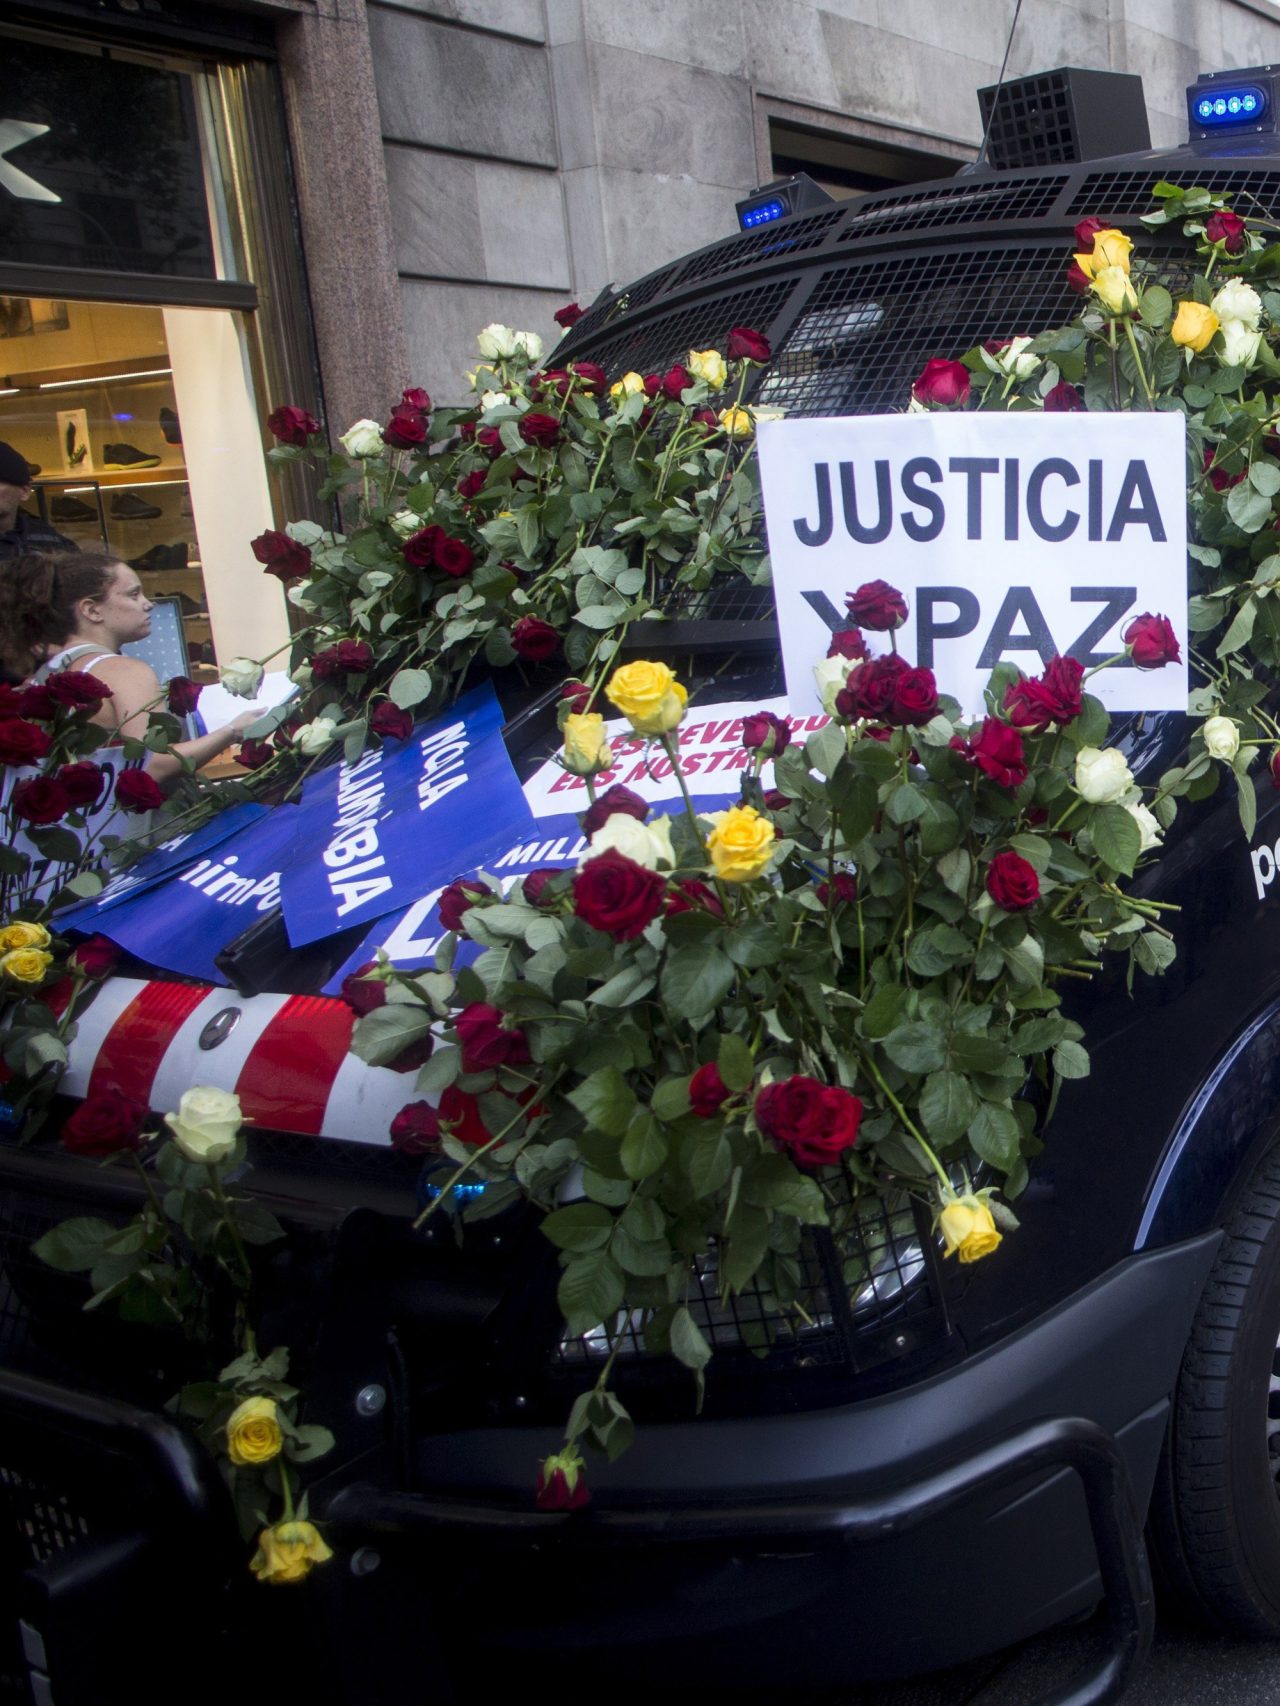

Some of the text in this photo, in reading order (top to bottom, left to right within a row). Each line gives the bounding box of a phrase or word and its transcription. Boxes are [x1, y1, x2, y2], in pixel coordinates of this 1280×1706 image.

[793, 456, 1168, 547] JUSTICIA
[915, 586, 1154, 669] PAZ
[494, 836, 588, 868] MILL
